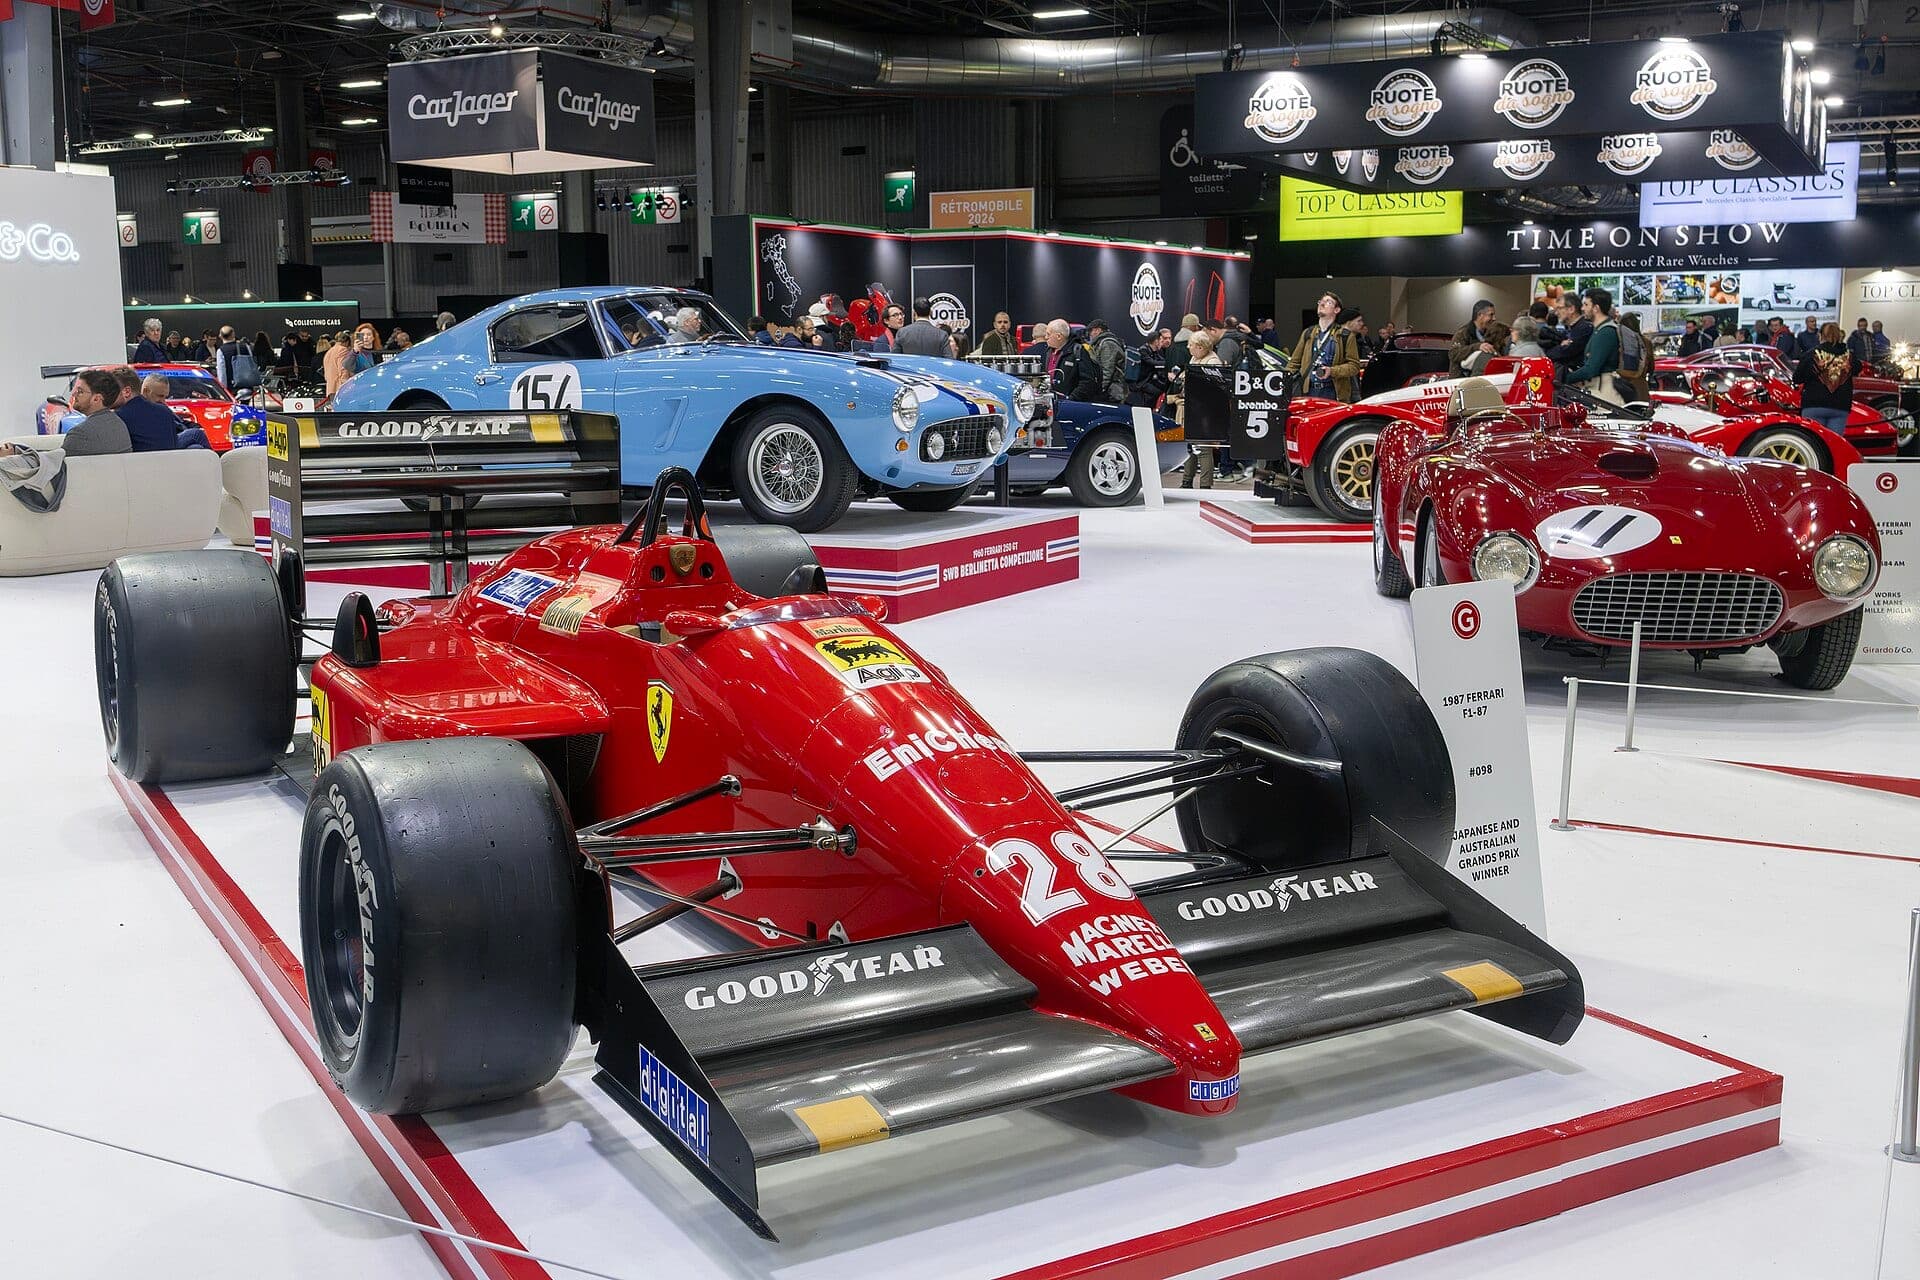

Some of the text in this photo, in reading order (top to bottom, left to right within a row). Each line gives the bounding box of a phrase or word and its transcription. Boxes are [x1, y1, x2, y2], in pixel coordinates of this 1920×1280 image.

[1502, 79, 1567, 95] RUOTE
[1639, 69, 1708, 86] RUOTE
[1373, 88, 1433, 104] RUOTE
[1496, 91, 1573, 111] da sogno
[1633, 82, 1715, 103] da sogno
[407, 90, 519, 128] CarJager
[557, 86, 641, 131] CarJager
[1251, 96, 1309, 112] RUOTE
[1368, 101, 1440, 120] da sogno
[1246, 108, 1315, 127] da sogno
[1499, 142, 1549, 154] RUOTE
[1603, 137, 1655, 149] RUOTE
[1400, 147, 1449, 160] RUOTE
[940, 199, 1023, 214] RÉTROMOBILE
[1296, 194, 1336, 214] TOP
[968, 213, 995, 224] 2026
[1507, 221, 1789, 251] TIME ON SHOW
[1549, 253, 1739, 270] The Excellence of Rare Watches
[1134, 286, 1161, 300] RUOTE
[931, 310, 965, 320] UOTE
[1238, 400, 1278, 410] brembo
[1245, 411, 1269, 439] 5
[943, 548, 1044, 582] SWB BERLINETTA COMPETIZIONE
[857, 664, 921, 684] Agip
[1442, 687, 1504, 707] 1987 FERRARI
[1462, 705, 1488, 719] F1-87
[1469, 764, 1493, 777] #098
[1452, 818, 1520, 841] JAPANESE AND
[1459, 833, 1516, 855] AUSTRALIAN
[1458, 847, 1520, 870] GRANDS PRIX
[985, 830, 1137, 928] 28
[1471, 865, 1510, 882] WINNER
[1089, 956, 1196, 997] WEBE
[640, 1062, 706, 1150] digital
